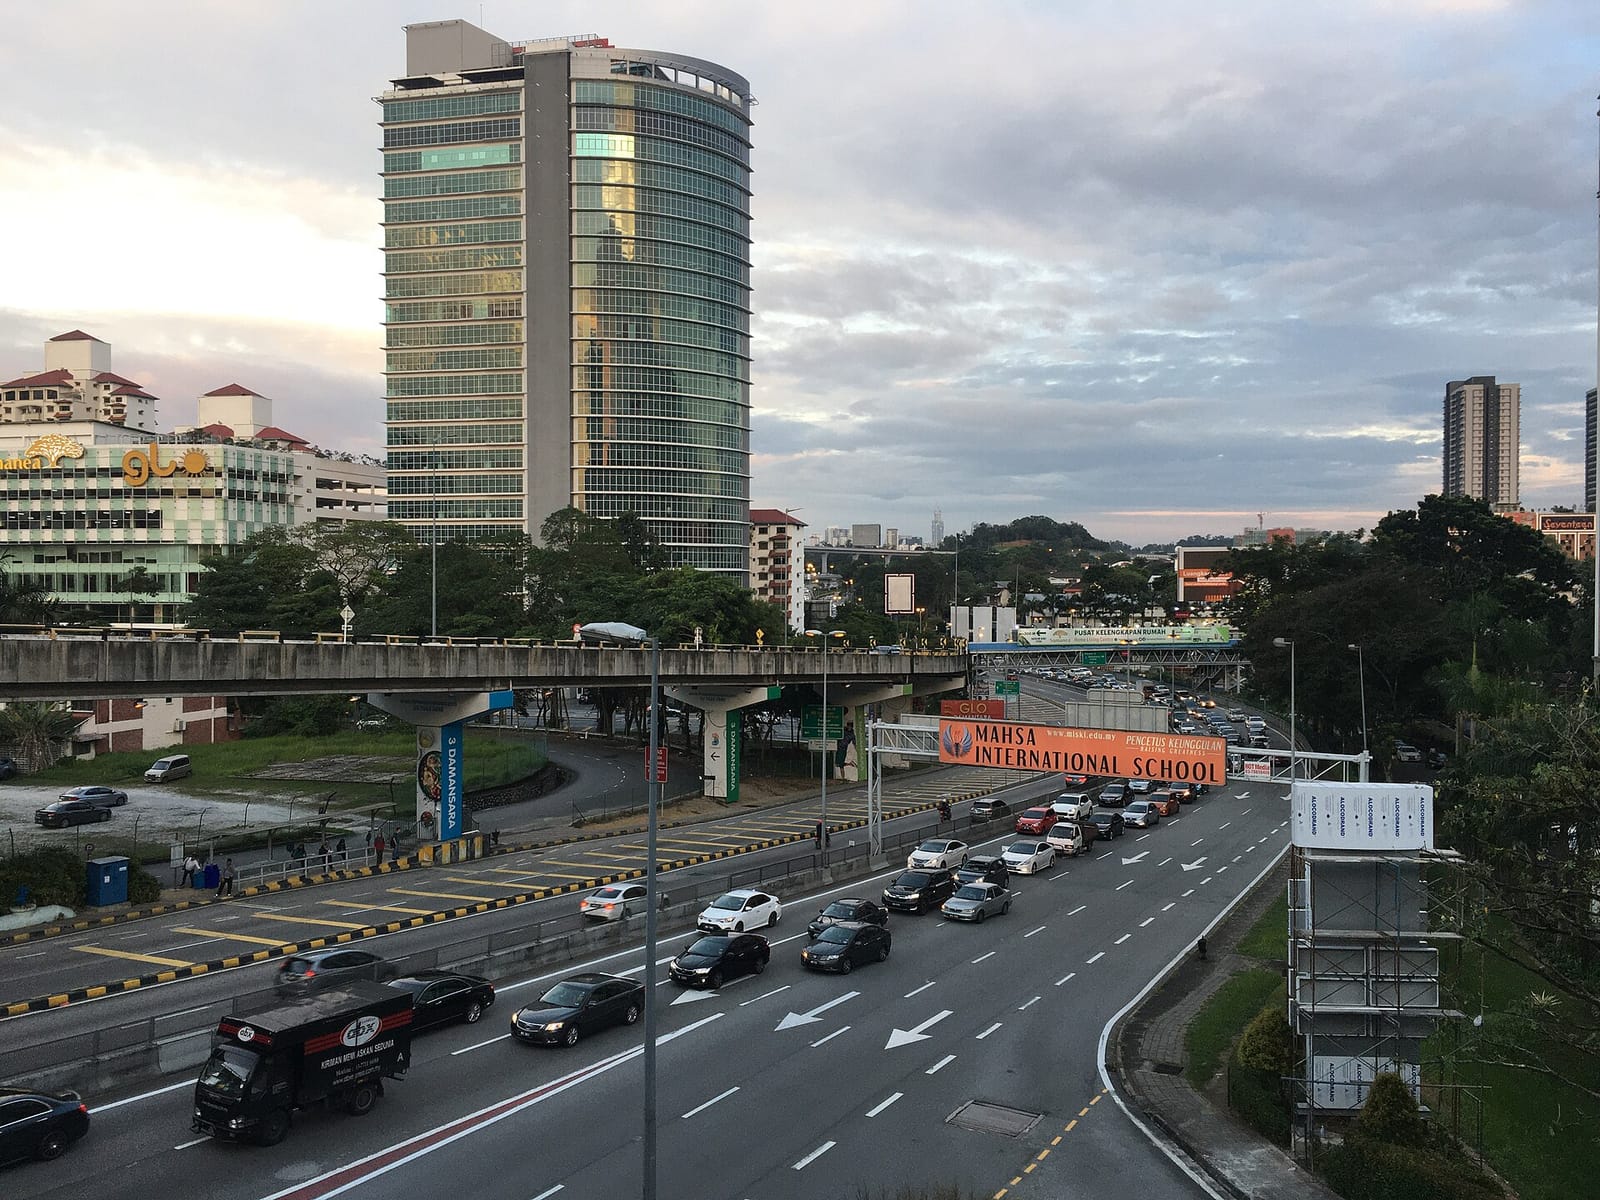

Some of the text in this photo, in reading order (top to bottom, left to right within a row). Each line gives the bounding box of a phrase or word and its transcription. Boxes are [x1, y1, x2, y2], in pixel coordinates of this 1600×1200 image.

[960, 702, 987, 714] GLO
[975, 725, 1036, 746] MAHSA
[1126, 735, 1222, 751] PENCETUS KEUNGGULAN
[1169, 748, 1207, 757] GREATNESS
[975, 746, 1219, 783] INTERNATIONAL SCHOOL
[448, 737, 456, 829] 3 DAMANSARA
[397, 1052, 404, 1062] A
